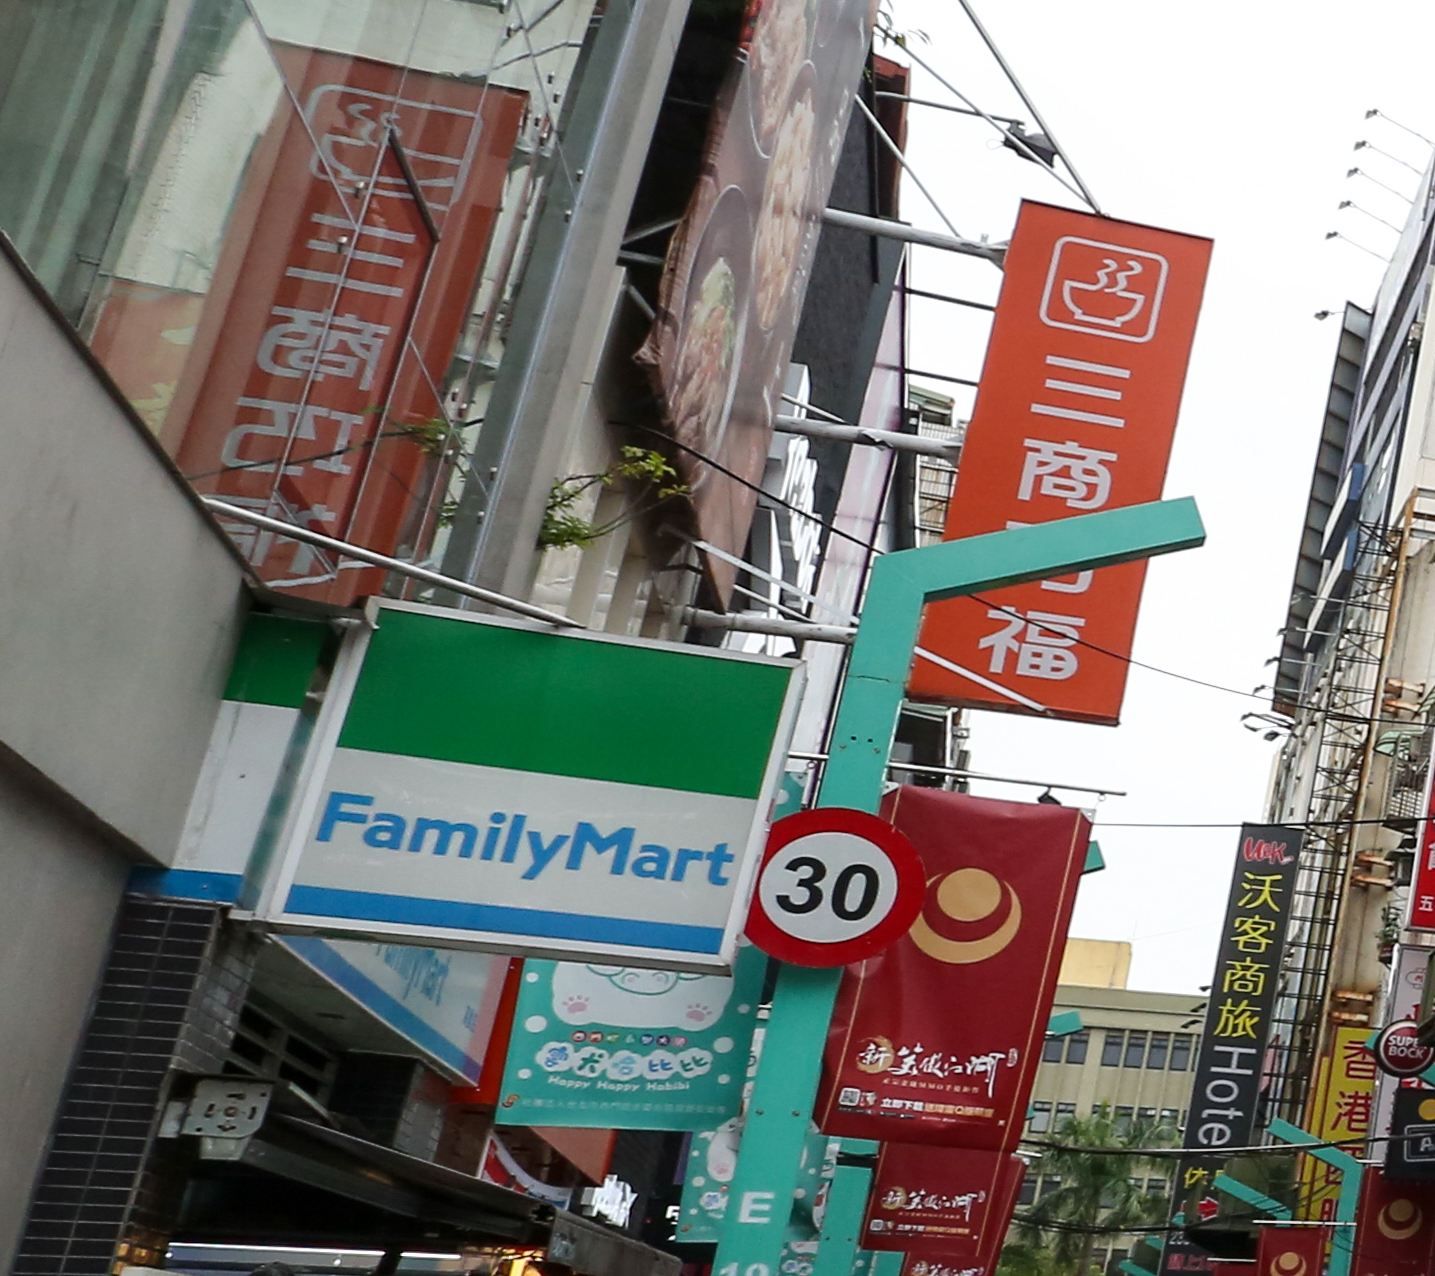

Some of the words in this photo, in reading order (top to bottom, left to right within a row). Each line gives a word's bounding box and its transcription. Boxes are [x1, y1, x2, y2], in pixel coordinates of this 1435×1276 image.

[315, 791, 735, 886] FamilyMart
[774, 857, 881, 923] 30
[1214, 871, 1284, 1040] 沃客商旅
[1388, 1034, 1428, 1049] SUPE
[1388, 1045, 1426, 1059] BOCK
[548, 1076, 591, 1089] Happy
[597, 1080, 640, 1092] Happy
[1198, 1045, 1258, 1157] Hote
[738, 1191, 775, 1223] E
